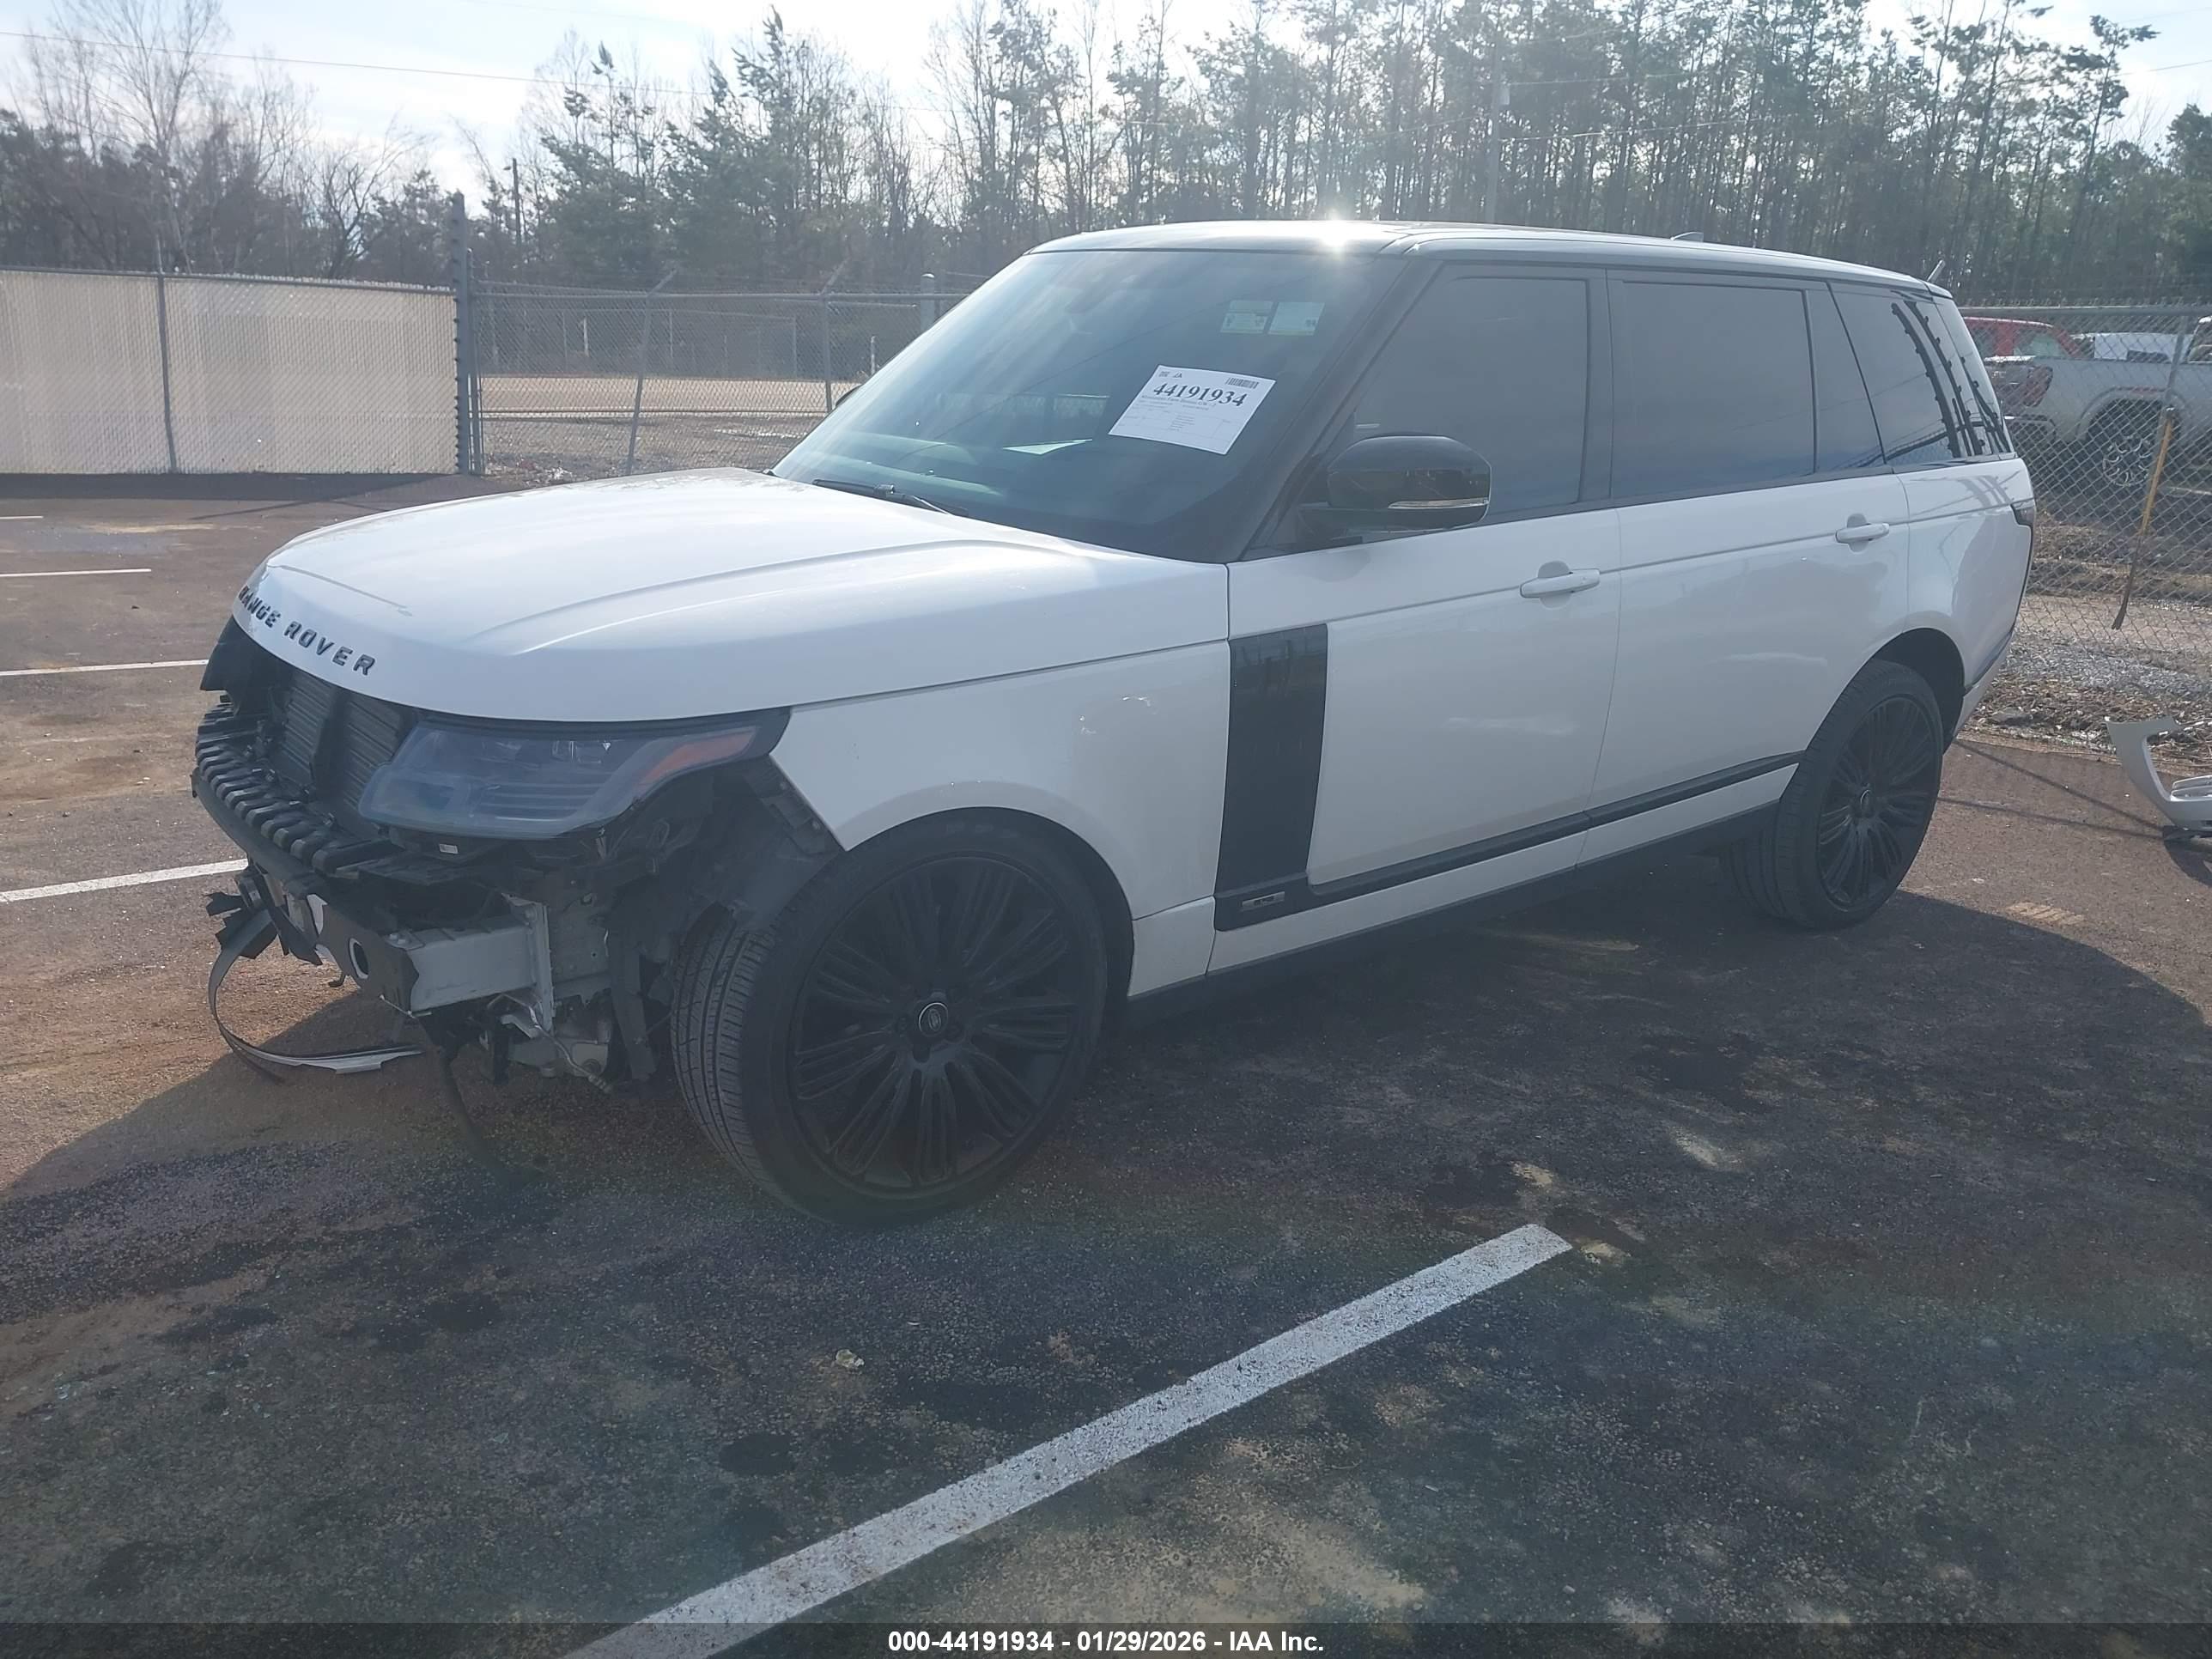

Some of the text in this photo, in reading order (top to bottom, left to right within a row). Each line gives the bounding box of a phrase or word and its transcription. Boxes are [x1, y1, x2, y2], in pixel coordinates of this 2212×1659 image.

[1153, 383, 1248, 407] 44191934
[239, 585, 375, 675] RANGE ROVER
